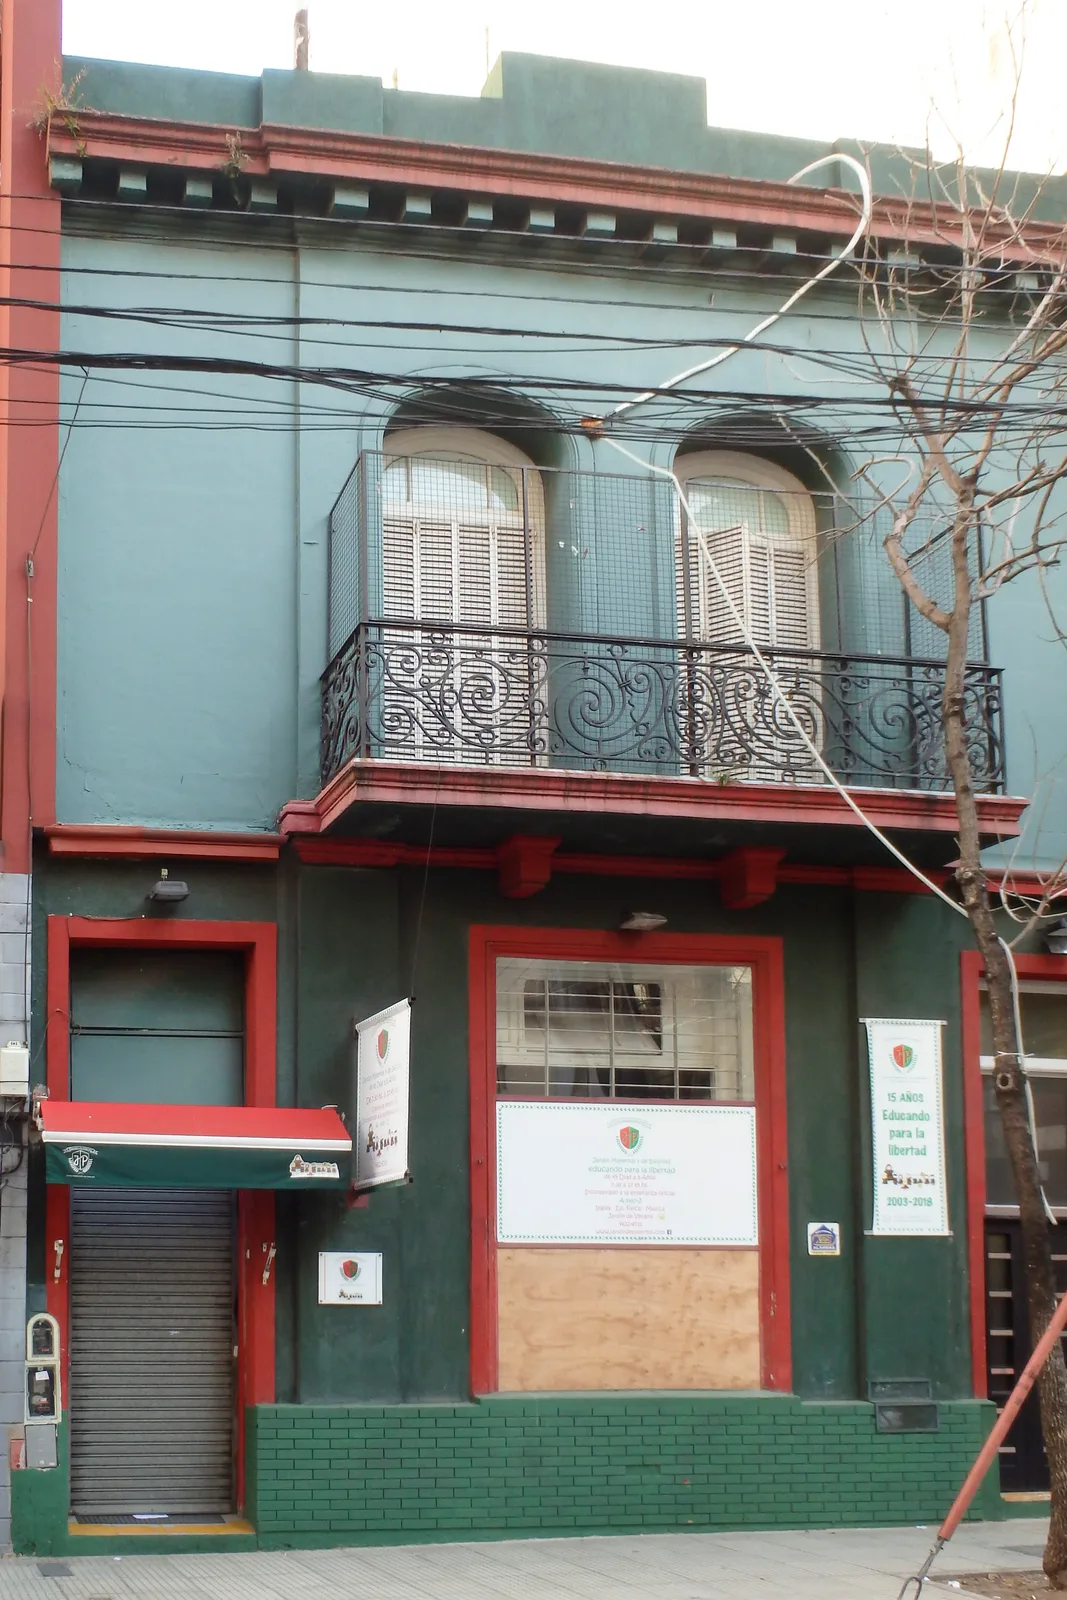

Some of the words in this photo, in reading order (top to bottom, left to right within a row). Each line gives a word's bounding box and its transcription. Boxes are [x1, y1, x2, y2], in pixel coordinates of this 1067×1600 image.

[887, 1092, 897, 1103] 15
[900, 1090, 924, 1103] AÑOS
[882, 1109, 931, 1122] Educando
[889, 1128, 912, 1140] para
[915, 1127, 925, 1139] la
[888, 1144, 927, 1156] libertad
[588, 1166, 623, 1174] educando
[887, 1196, 933, 1207] 2003-2018
